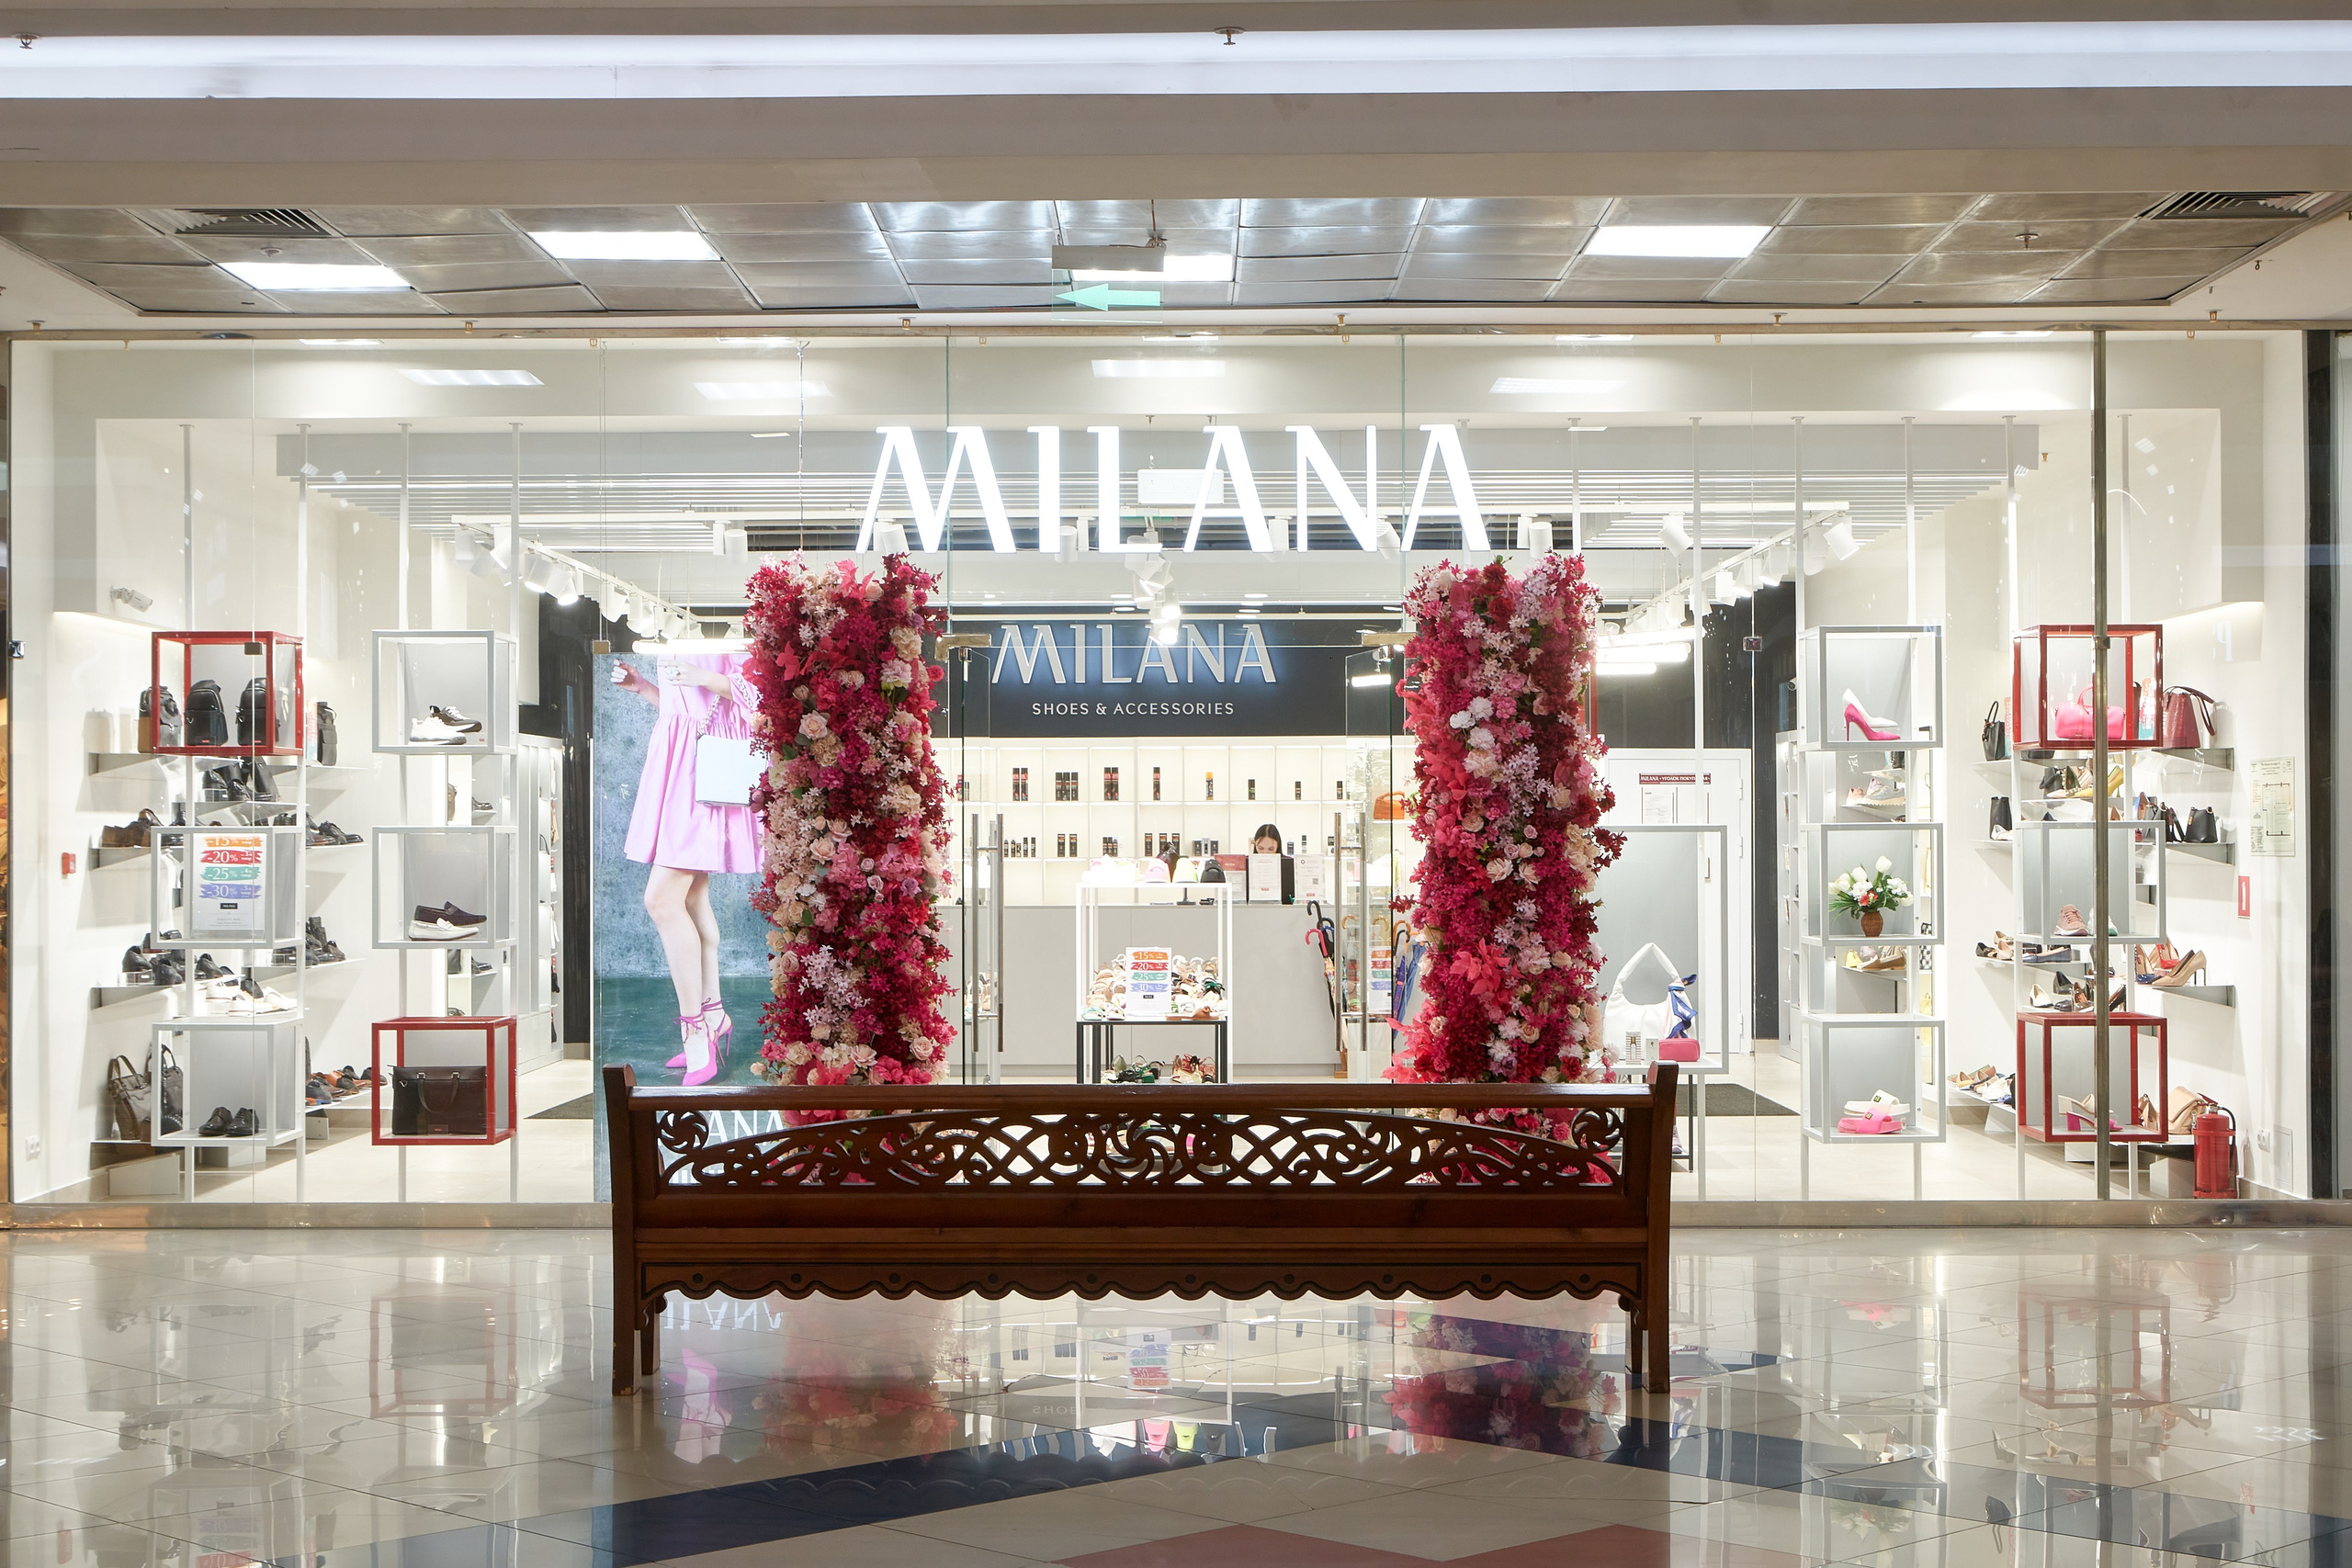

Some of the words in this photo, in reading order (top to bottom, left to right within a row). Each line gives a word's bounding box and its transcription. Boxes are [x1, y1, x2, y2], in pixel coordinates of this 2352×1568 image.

[855, 424, 1491, 553] MILANA
[991, 623, 1277, 684] MILANA
[1032, 702, 1090, 716] SHOES
[1095, 702, 1107, 716] &
[1113, 702, 1235, 716] ACCESSORIES
[207, 851, 239, 863] -20%
[207, 867, 239, 880] -25%
[207, 885, 238, 897] -30%
[707, 1110, 785, 1144] ANA
